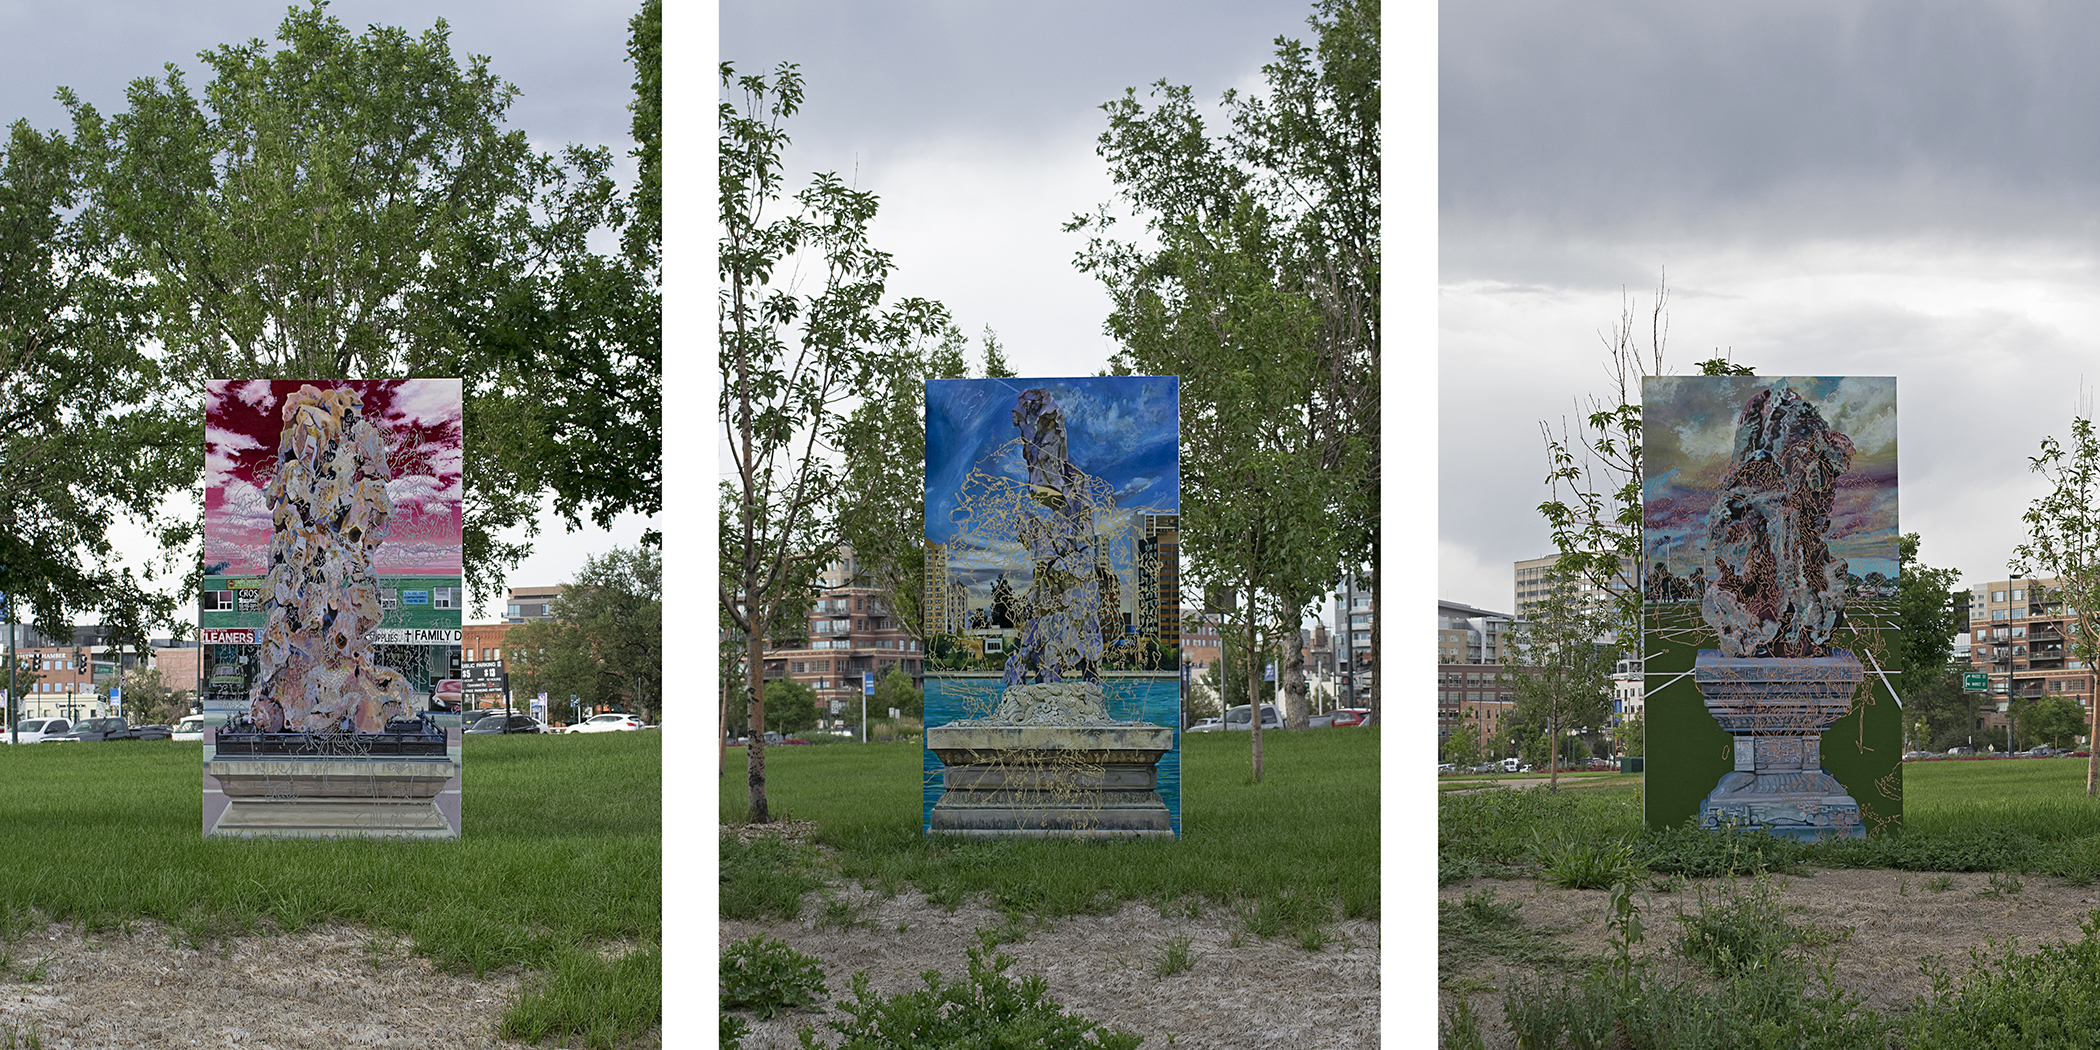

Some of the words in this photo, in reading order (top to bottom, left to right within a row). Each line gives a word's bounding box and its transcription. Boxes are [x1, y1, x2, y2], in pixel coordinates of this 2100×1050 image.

[204, 632, 254, 643] LEANERS
[415, 630, 451, 641] FAMILY
[462, 670, 471, 678] $5
